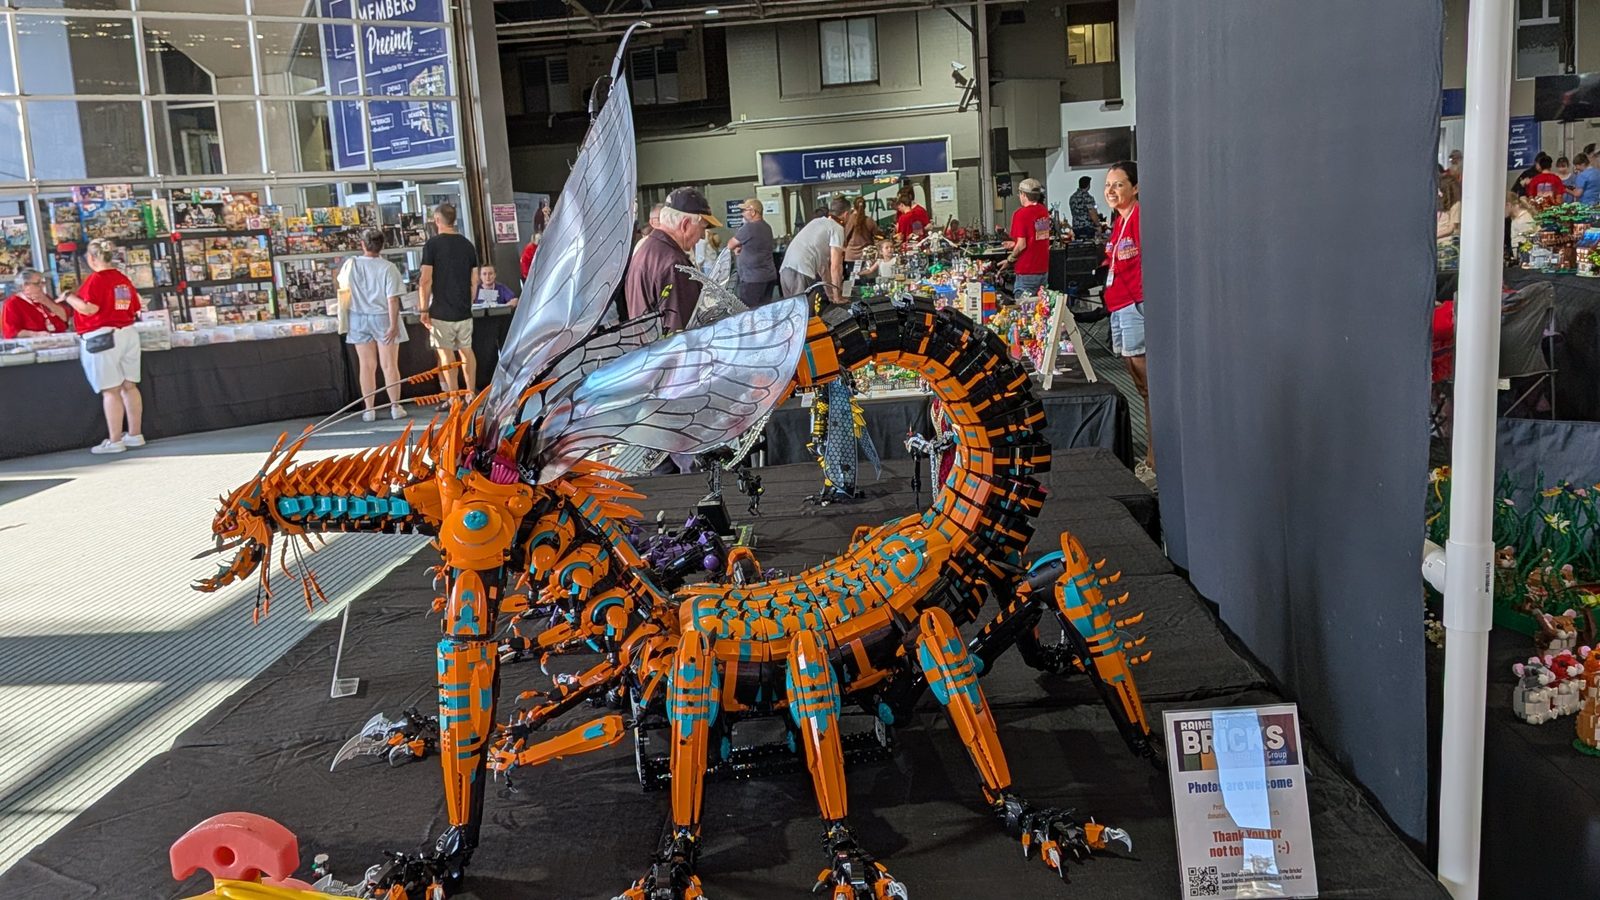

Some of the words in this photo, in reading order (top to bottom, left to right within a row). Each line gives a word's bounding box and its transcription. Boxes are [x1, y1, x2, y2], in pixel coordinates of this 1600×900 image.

[359, 0, 416, 20] MEMBERS
[366, 26, 414, 64] Precinct
[814, 159, 834, 169] THE
[838, 155, 892, 168] TERRACES
[856, 168, 888, 178] Racecourse
[1181, 719, 1229, 730] RAINBW
[1182, 725, 1285, 755] BRICKS
[1213, 830, 1244, 843] Thank
[1266, 829, 1282, 839] for
[1209, 846, 1228, 857] not
